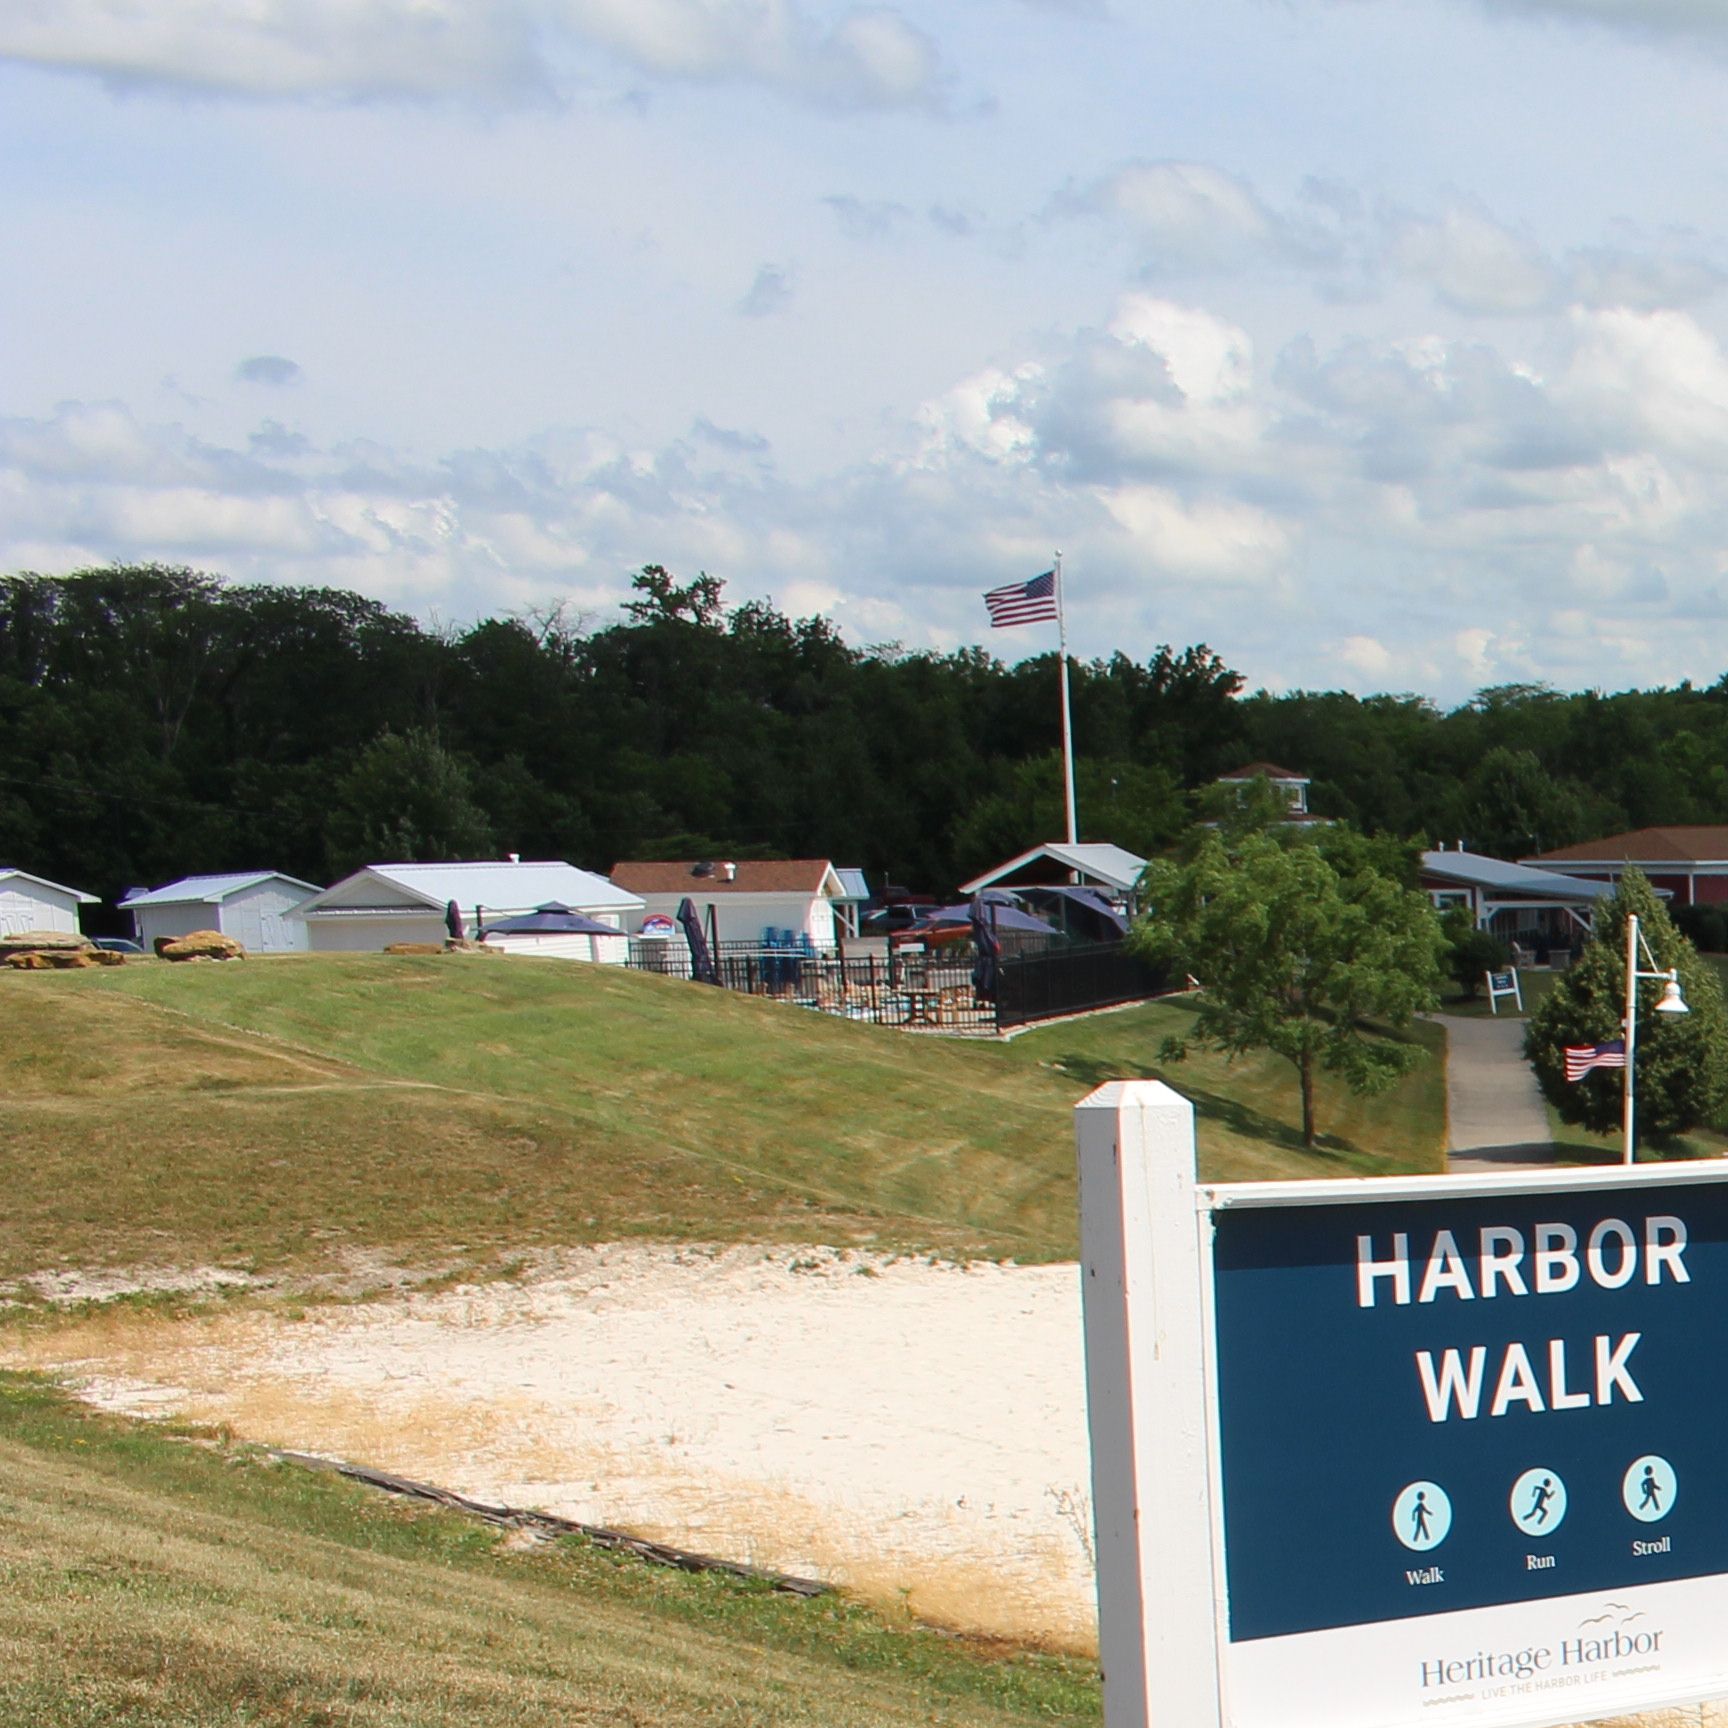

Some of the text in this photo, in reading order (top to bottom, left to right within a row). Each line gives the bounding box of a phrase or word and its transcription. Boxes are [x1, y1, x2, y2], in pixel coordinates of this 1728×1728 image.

[1355, 1214, 1691, 1308] HARBOR
[1416, 1331, 1644, 1423] WALK
[1632, 1537, 1671, 1556] Stroll
[1406, 1567, 1445, 1585] Walk
[1526, 1555, 1556, 1570] Run
[1421, 1630, 1664, 1688] Heritage Harbor
[1481, 1670, 1608, 1699] LIVE THE HARBOR LIFE
